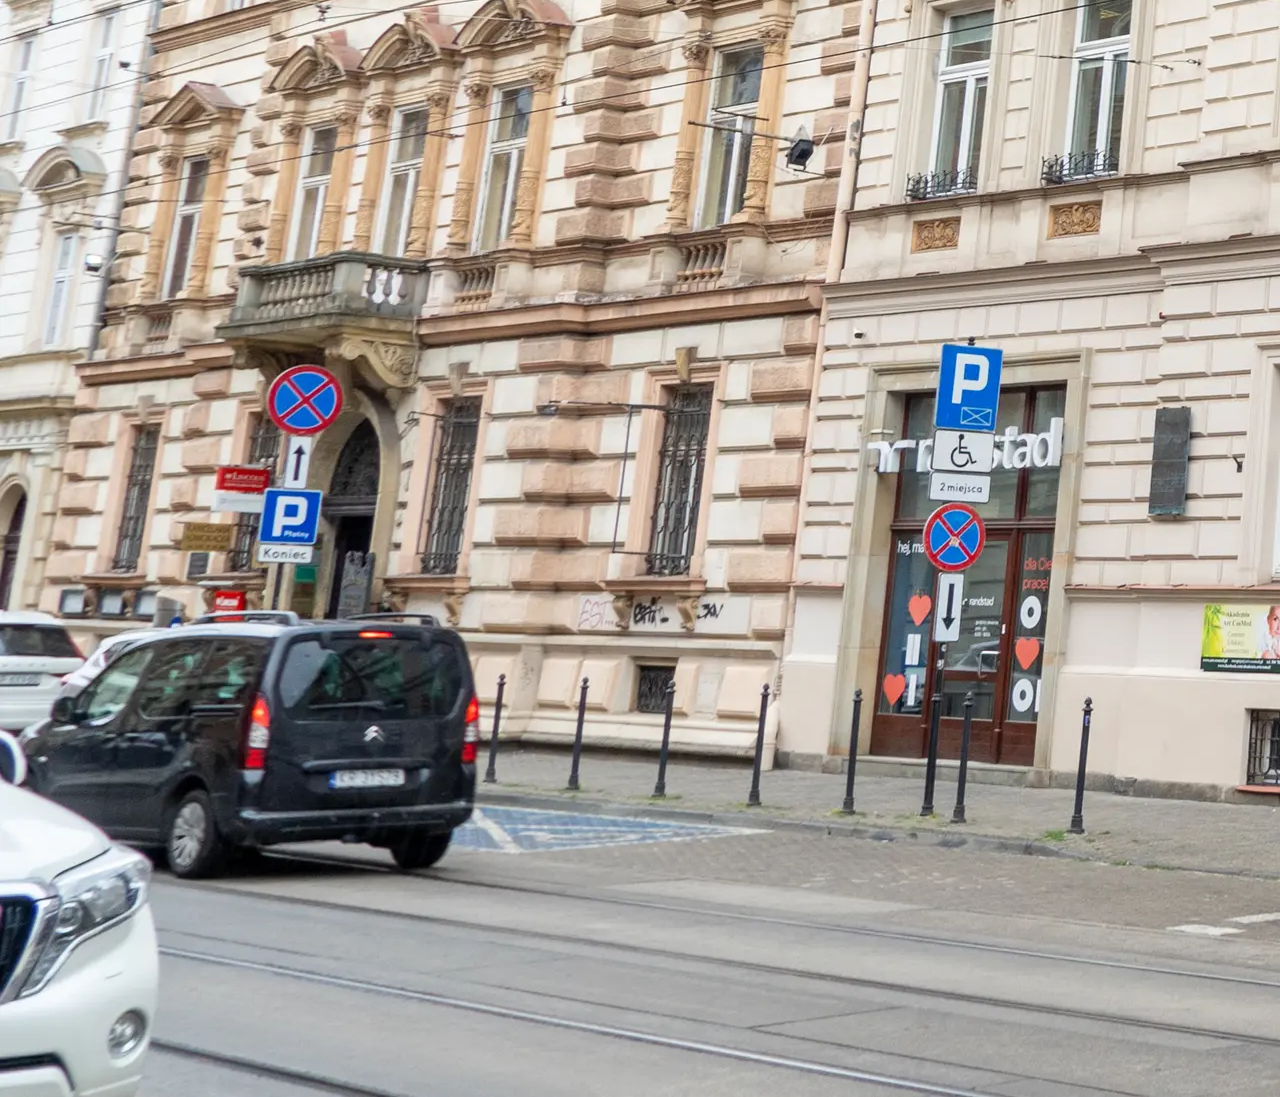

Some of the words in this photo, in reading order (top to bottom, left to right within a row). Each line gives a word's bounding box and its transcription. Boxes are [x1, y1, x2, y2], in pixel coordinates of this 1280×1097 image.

[951, 352, 990, 405] P
[939, 482, 946, 492] 2
[946, 483, 984, 495] miejsca
[271, 495, 309, 538] P
[262, 548, 307, 561] Koniec
[1038, 557, 1053, 571] Cie
[968, 595, 995, 607] randstad
